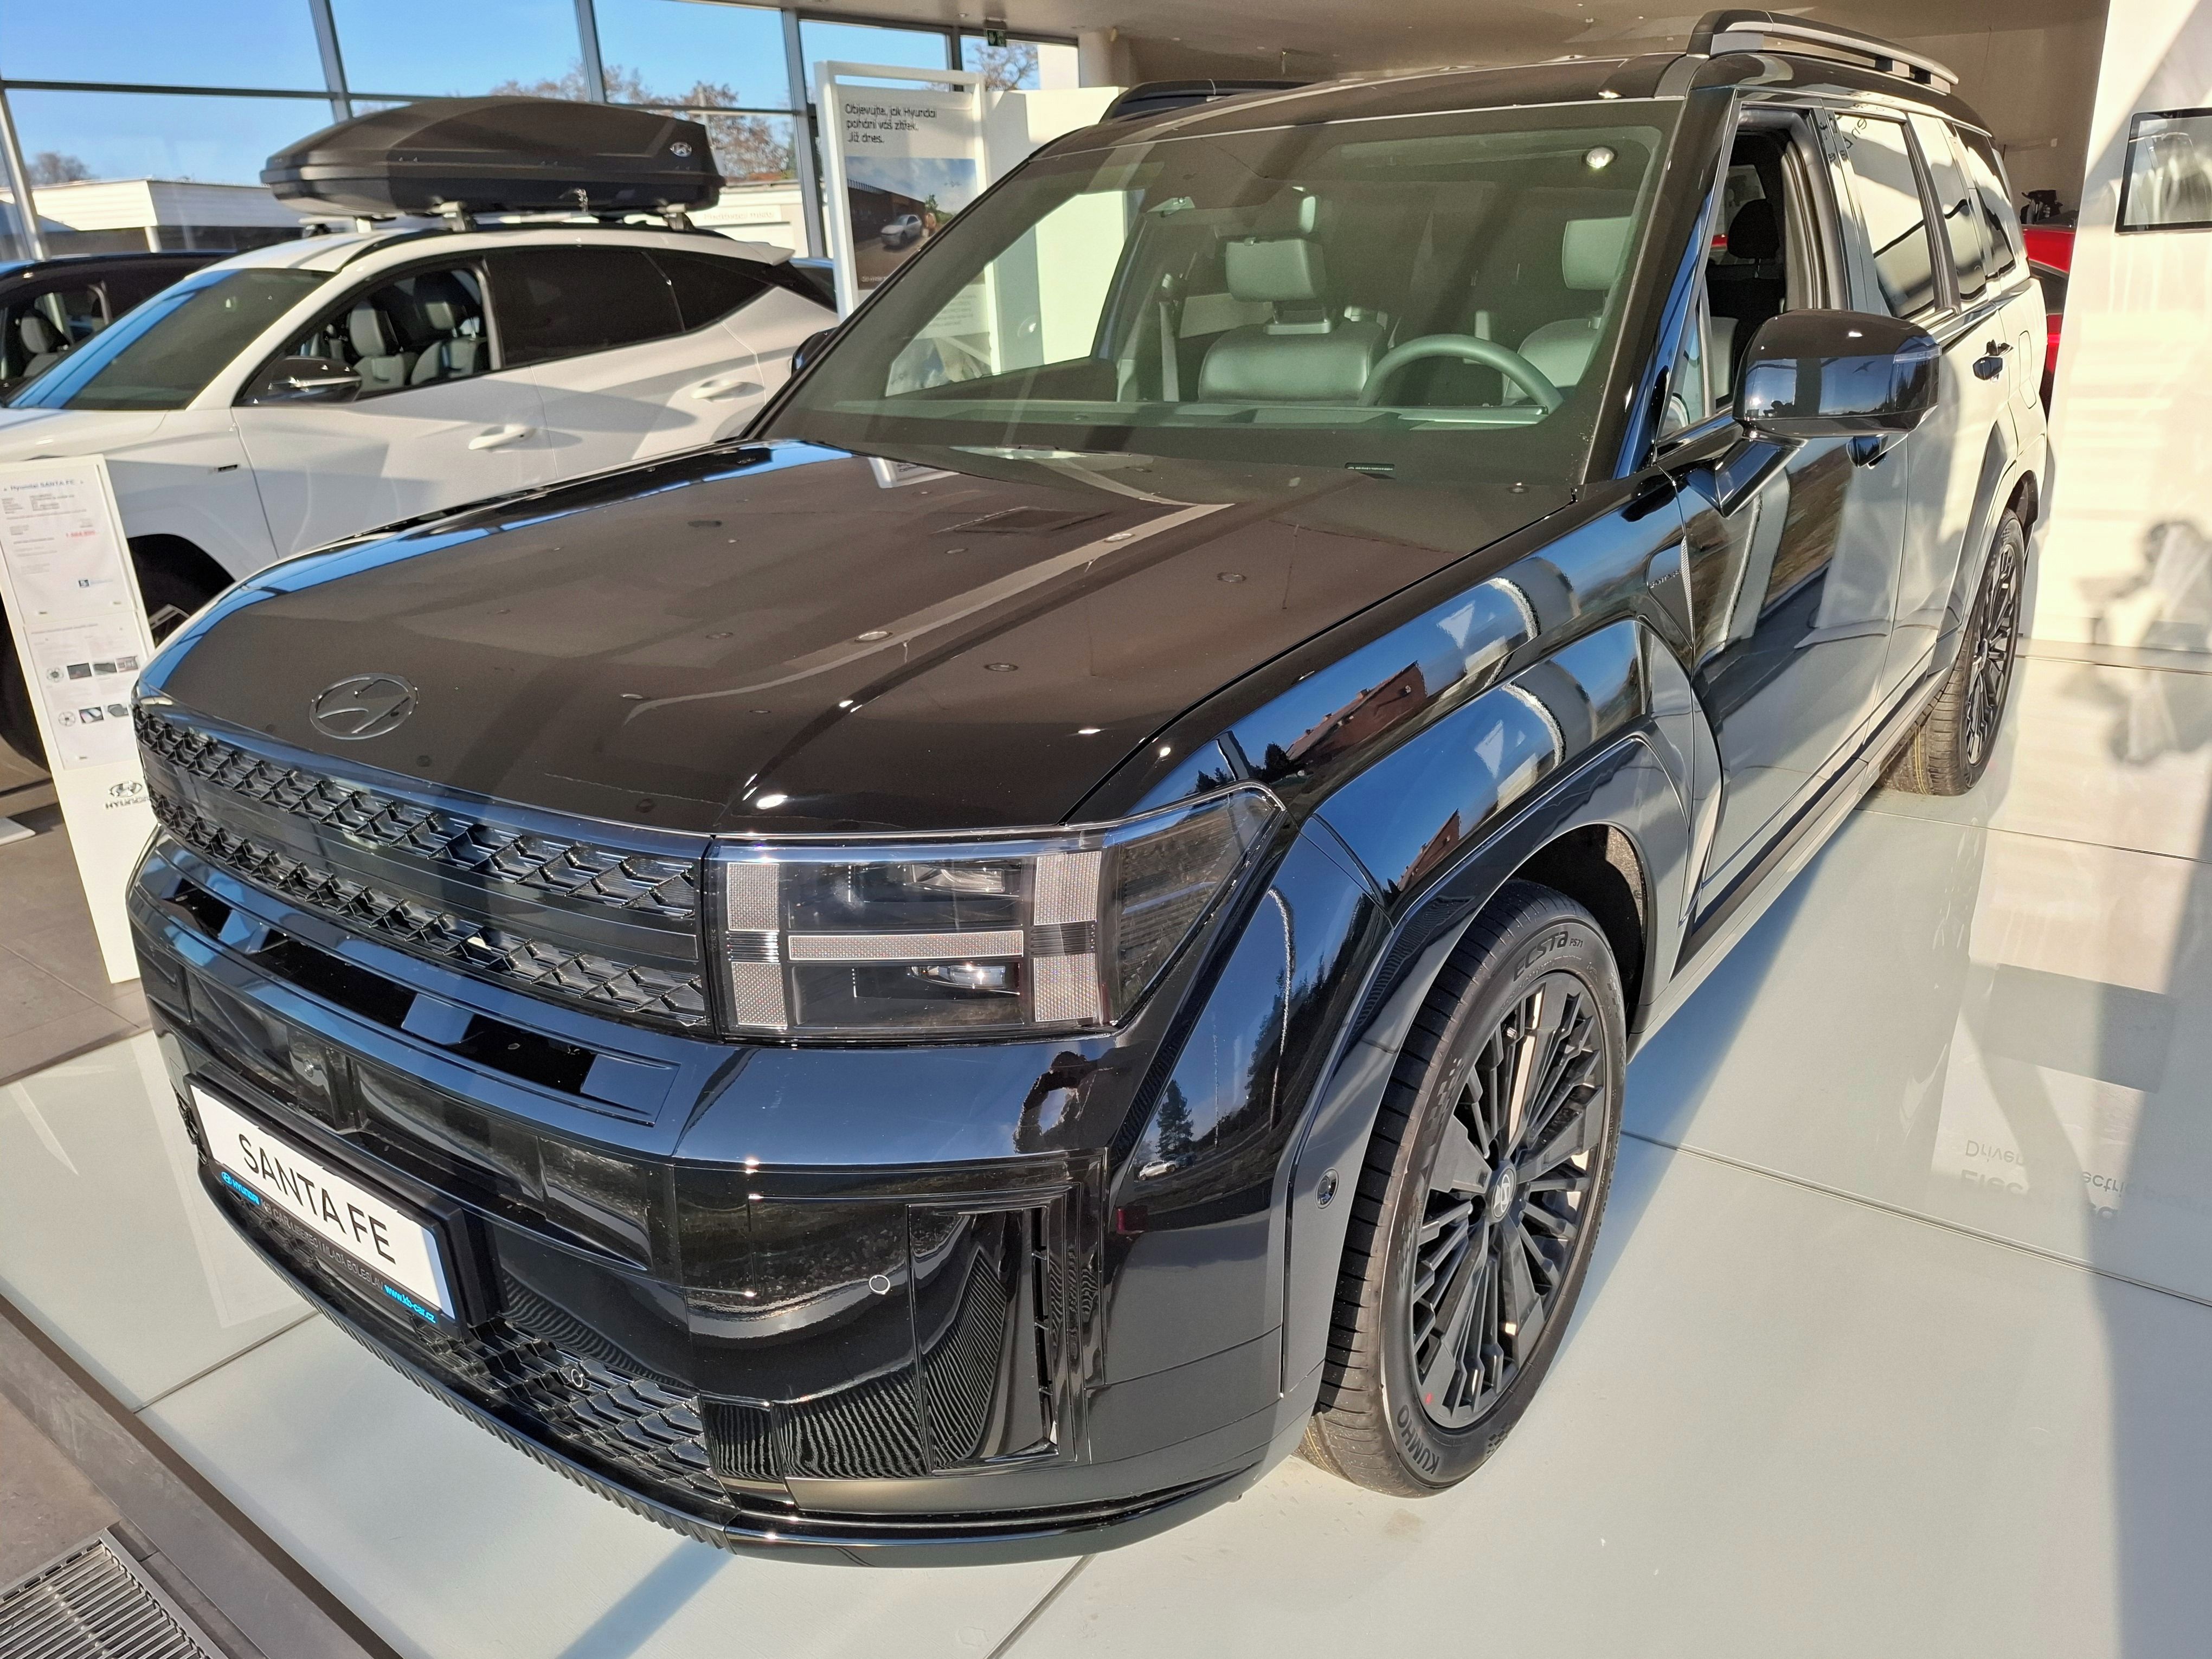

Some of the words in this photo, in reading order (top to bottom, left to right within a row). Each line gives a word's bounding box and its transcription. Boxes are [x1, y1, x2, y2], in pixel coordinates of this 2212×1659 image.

[1569, 938, 1584, 948] PS71
[232, 1179, 260, 1206] HYUNDAI
[273, 1208, 291, 1229] CAR
[291, 1223, 318, 1248] LIBEREC
[346, 1259, 383, 1290] BOLESLAV
[239, 1133, 346, 1234] SANTA
[347, 1203, 396, 1265] FE
[1397, 1404, 1439, 1475] KUMHO
